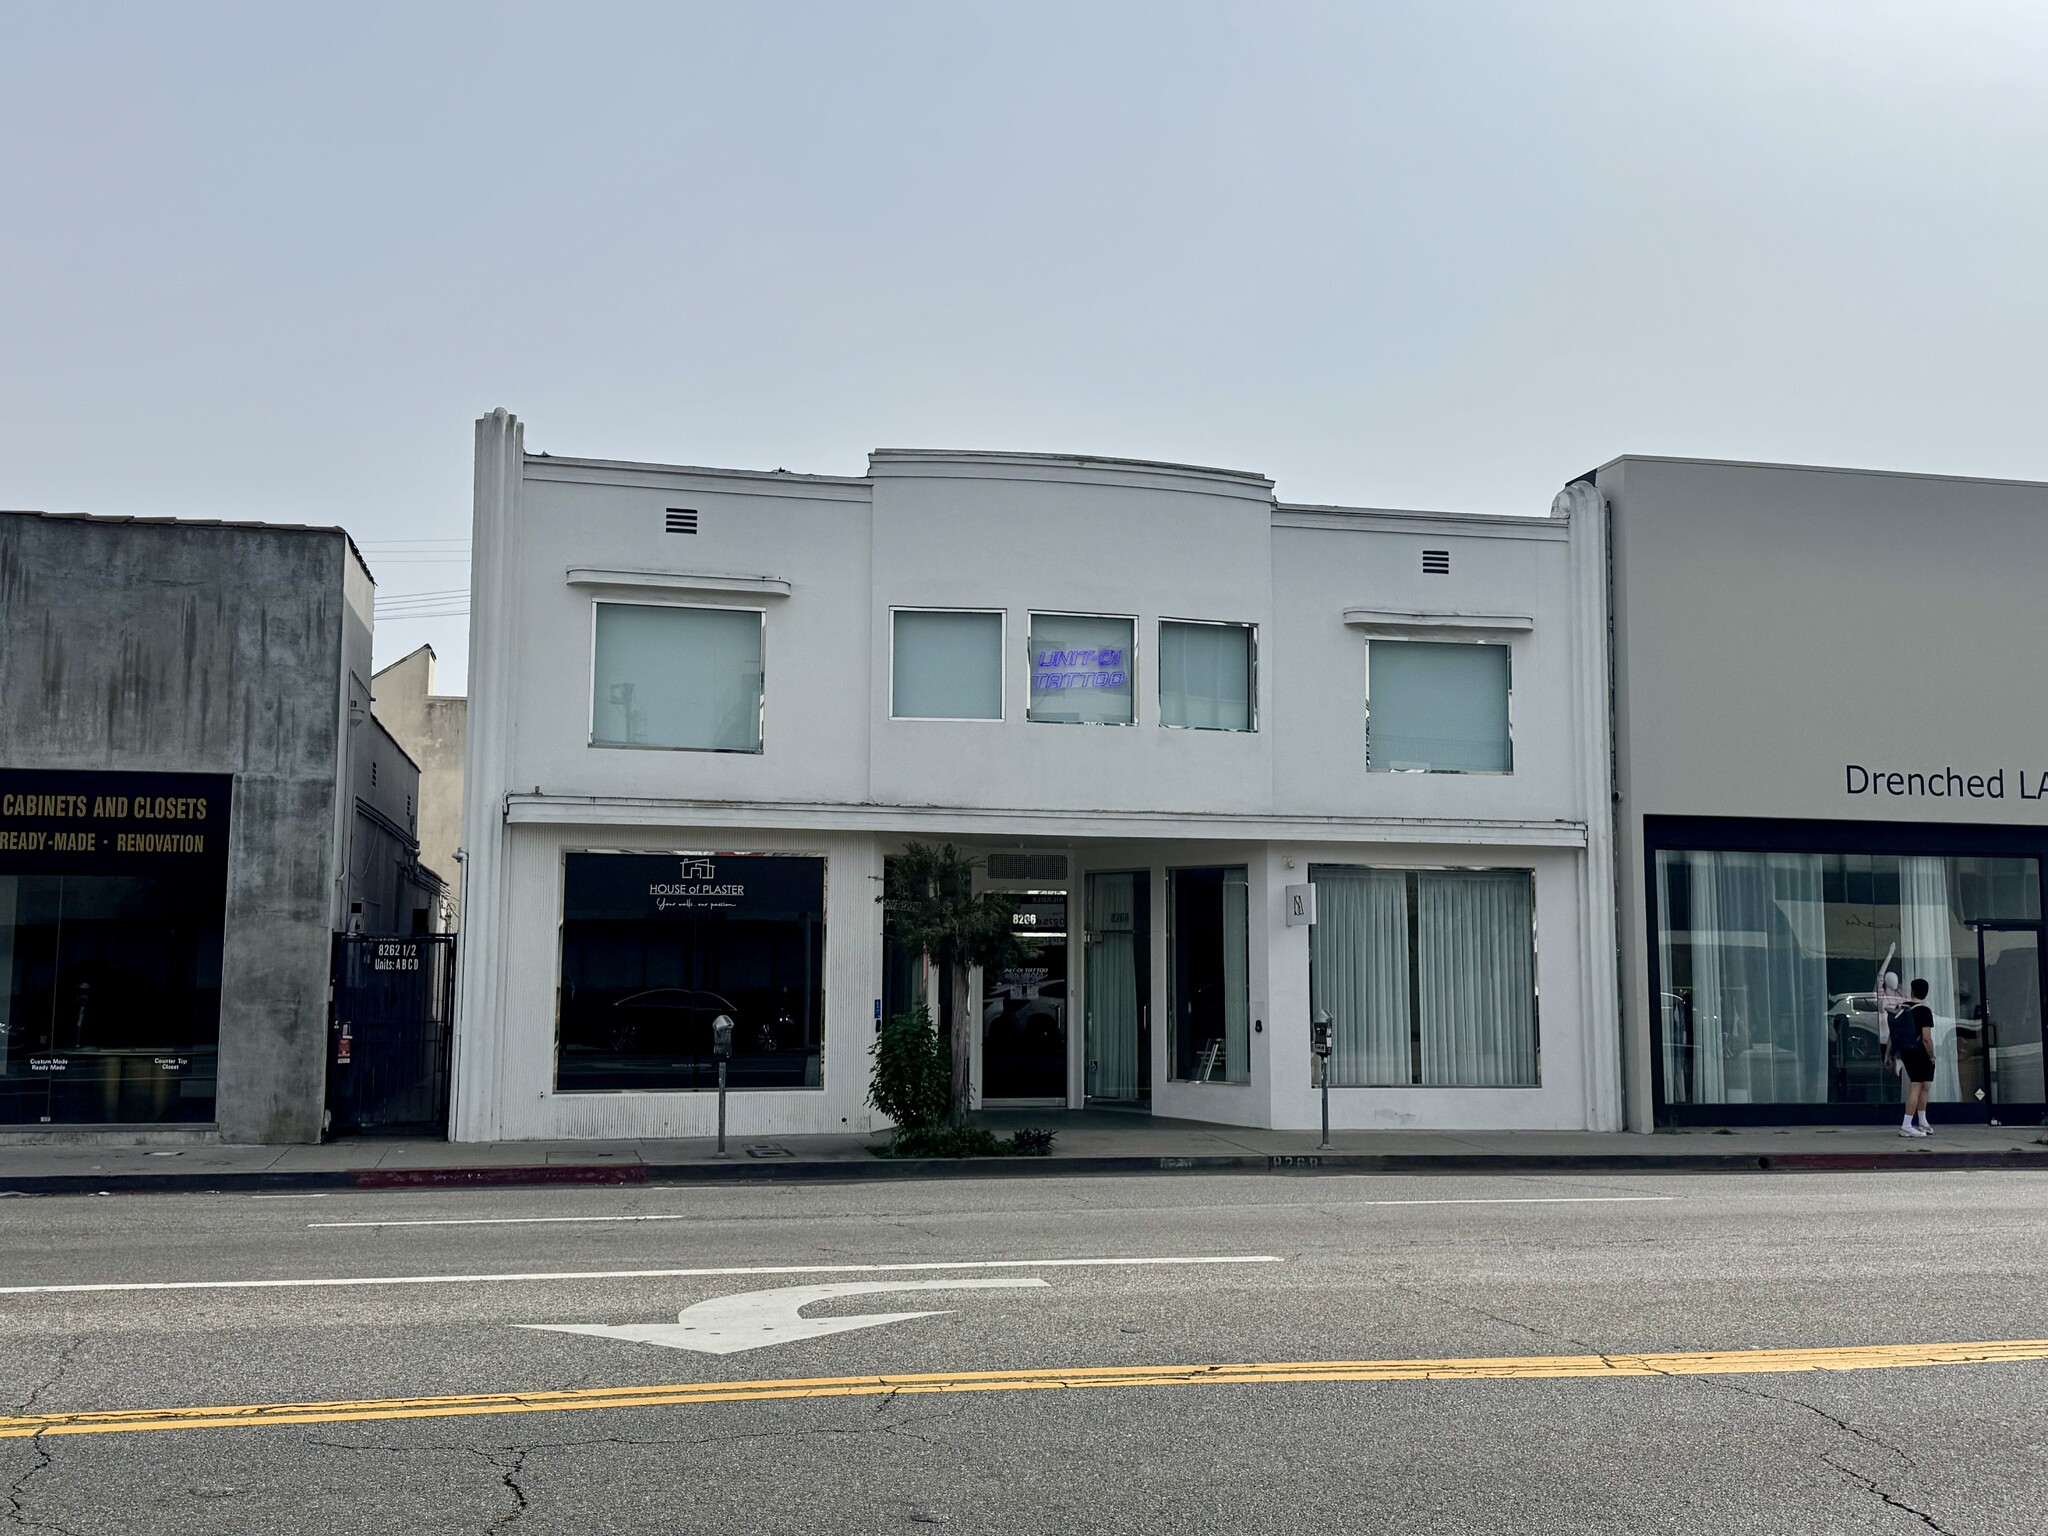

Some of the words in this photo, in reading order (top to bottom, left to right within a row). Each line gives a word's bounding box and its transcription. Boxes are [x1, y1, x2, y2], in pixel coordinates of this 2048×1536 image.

[1034, 672, 1125, 688] TATTOO
[1846, 764, 2004, 799] Drenched
[3, 793, 87, 817] CABINETS
[93, 796, 128, 818] AND
[134, 797, 207, 820] CLOSETS
[0, 831, 96, 851] READY-MADE
[117, 833, 204, 852] RENOVATION
[650, 884, 686, 895] HOUSE
[689, 884, 700, 894] of
[702, 884, 744, 895] PLASTER
[378, 944, 401, 956] 8262
[403, 944, 417, 957] 1/2
[375, 958, 395, 970] Units:
[154, 1057, 176, 1065] Counter
